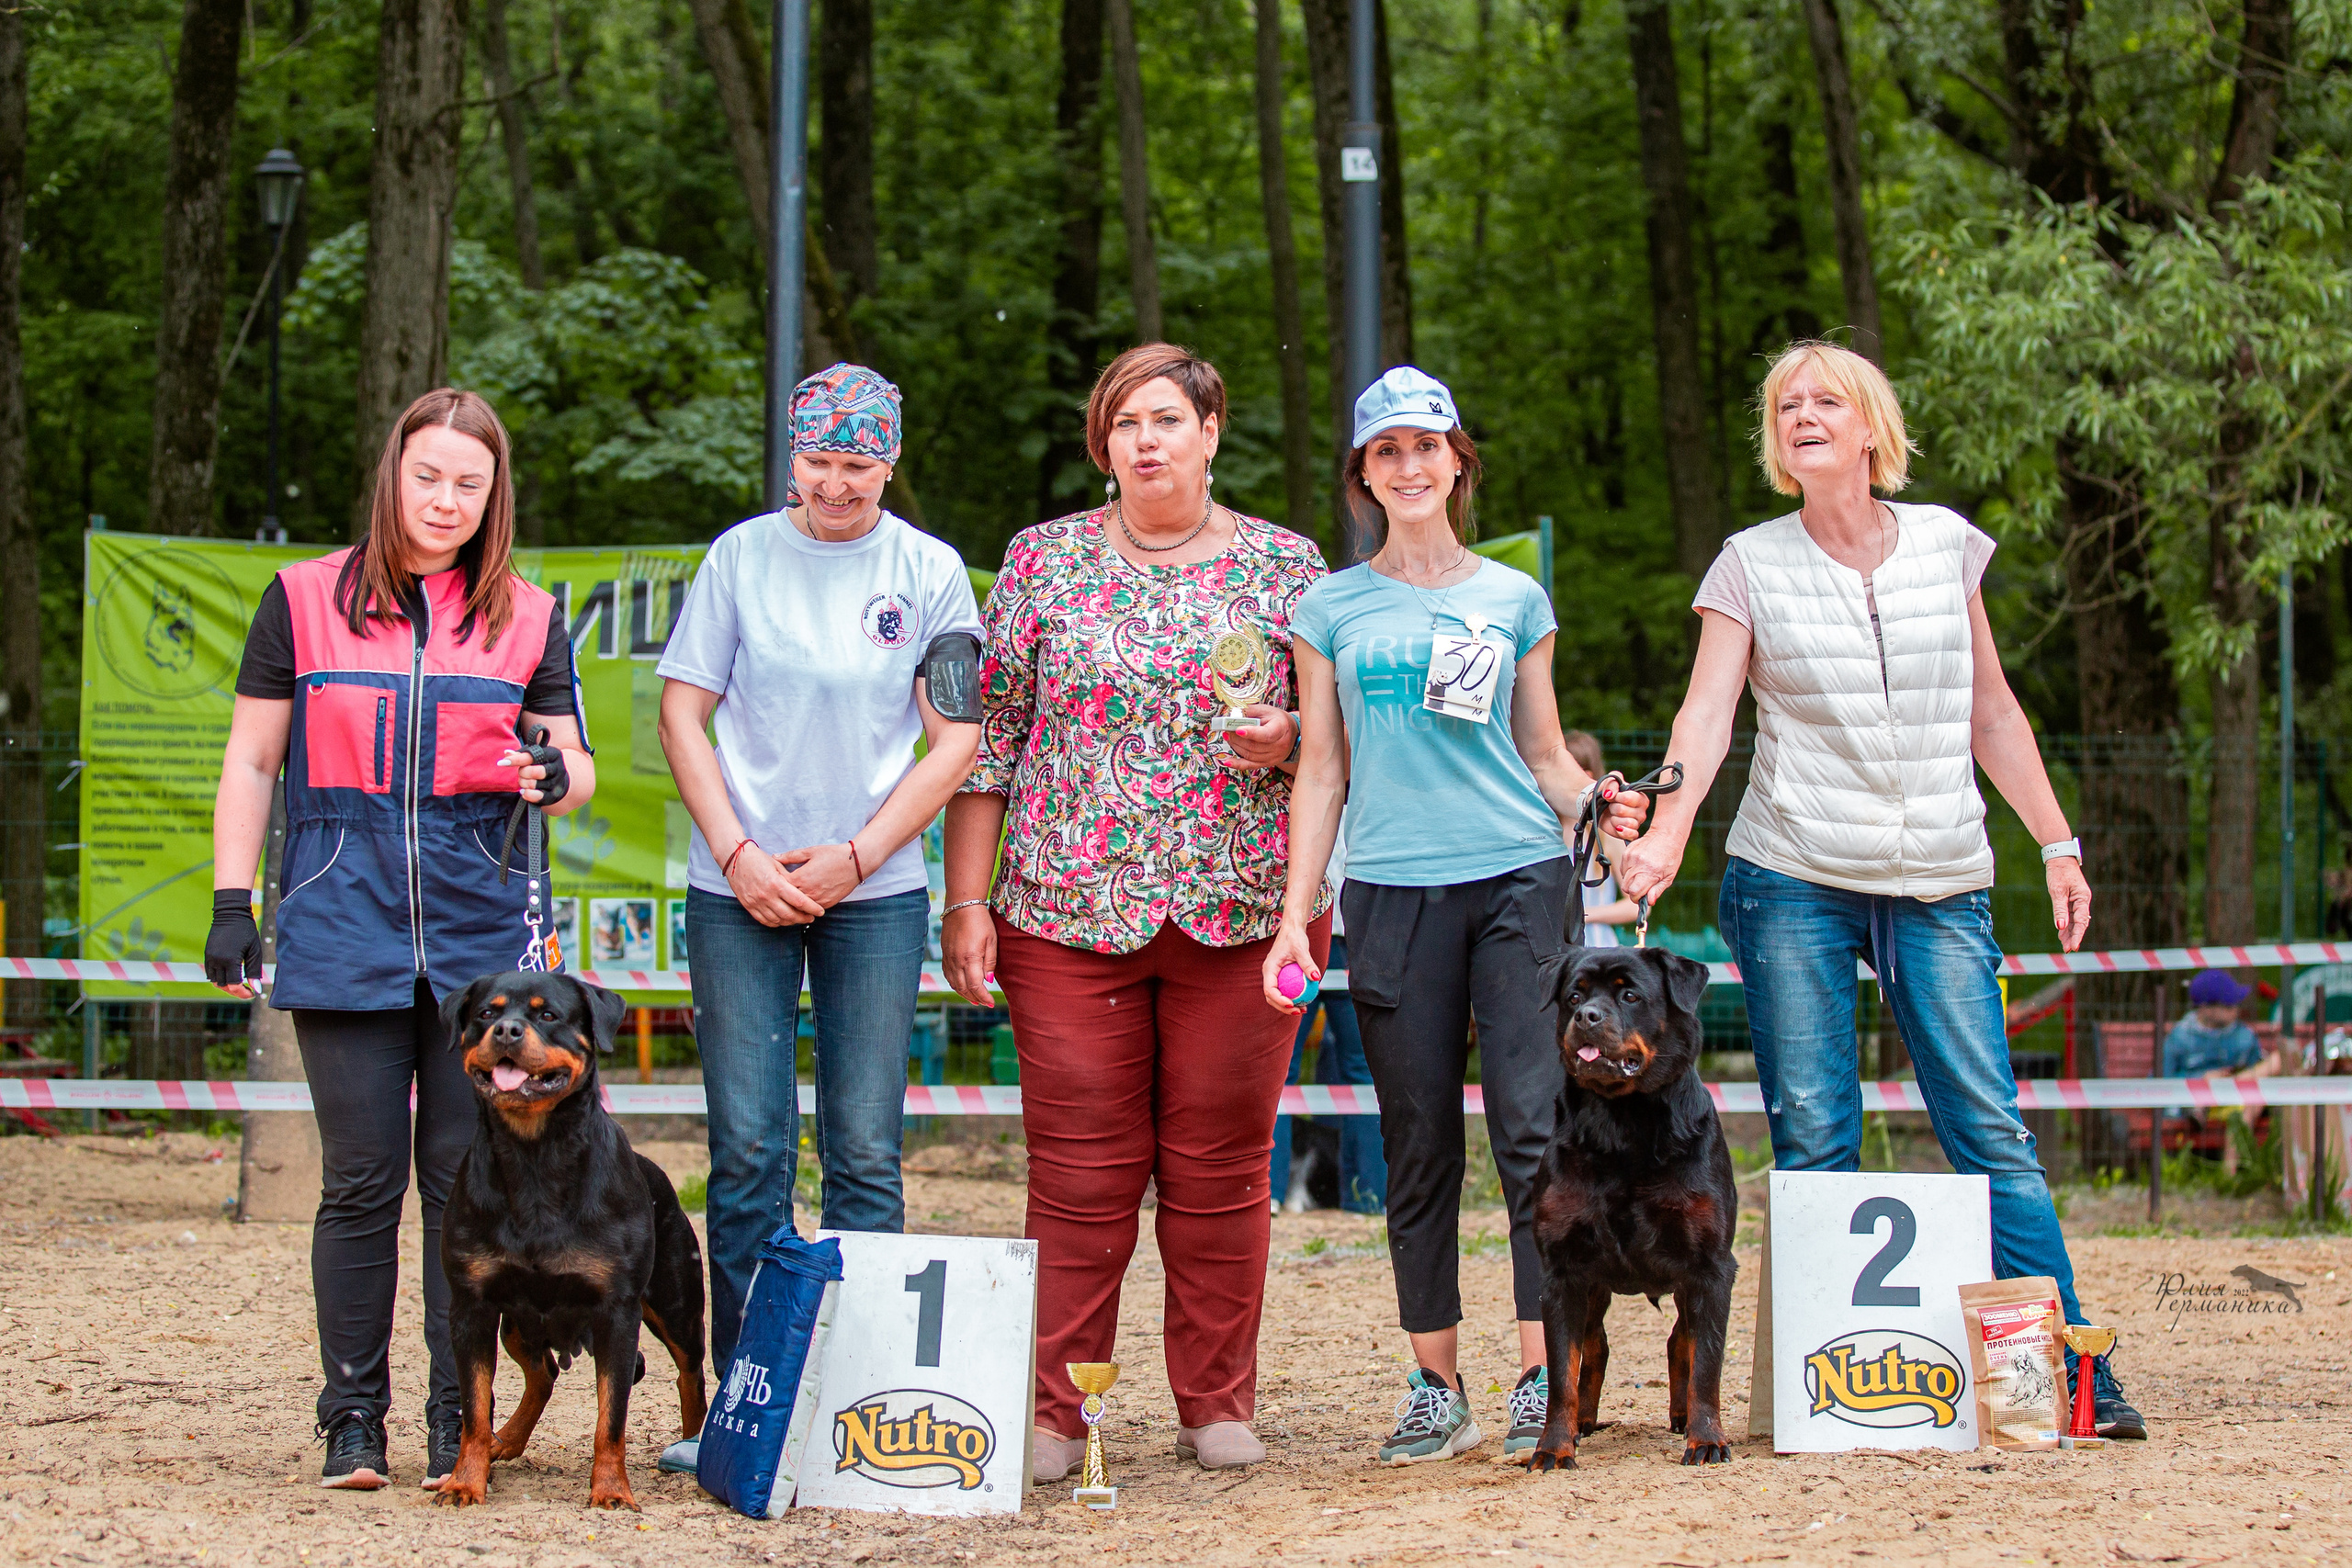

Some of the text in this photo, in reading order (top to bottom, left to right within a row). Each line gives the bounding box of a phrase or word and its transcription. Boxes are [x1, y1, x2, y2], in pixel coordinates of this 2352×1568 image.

[1365, 635, 1430, 669] RU
[1436, 640, 1496, 692] 30
[1397, 673, 1427, 695] TH
[1849, 1196, 1920, 1307] 2
[905, 1259, 947, 1368] 1
[1986, 1335, 2041, 1349] ПРОТЕИНОВЫЕ
[1806, 1342, 1958, 1419] Nutro
[713, 1410, 759, 1438] нежна
[835, 1402, 990, 1476] Nutro
